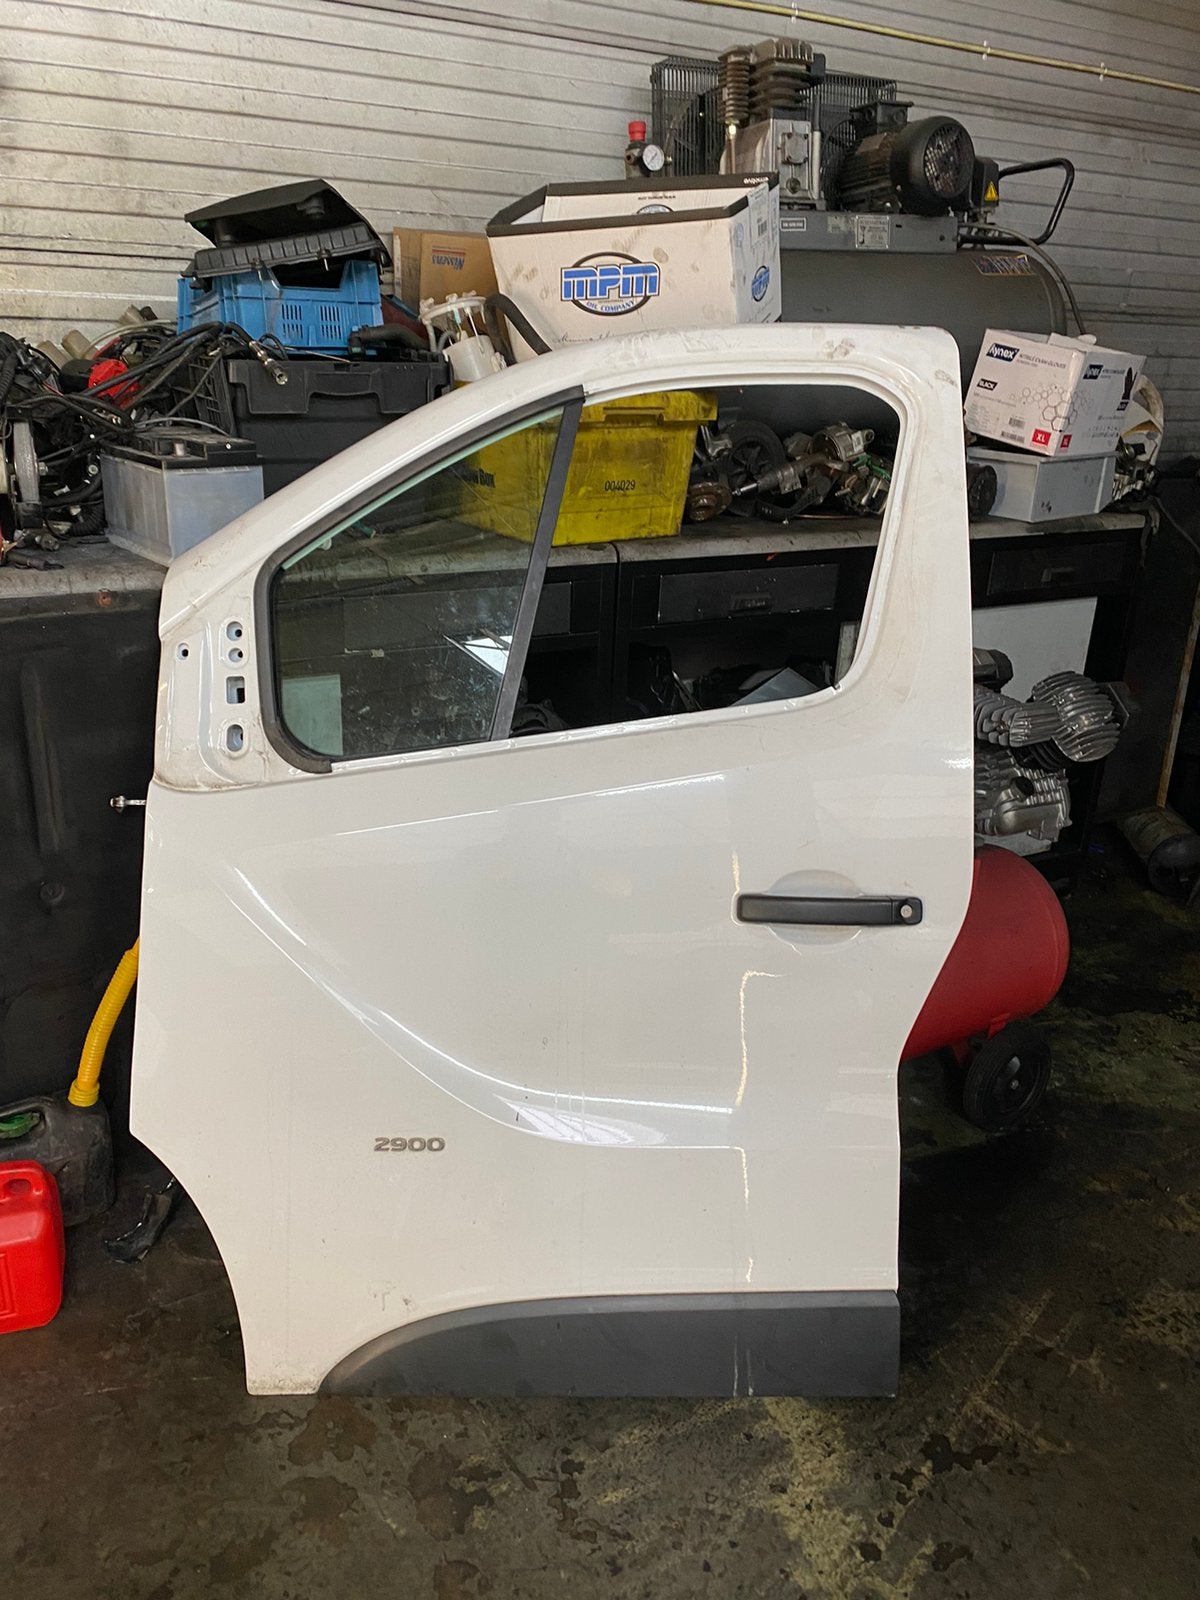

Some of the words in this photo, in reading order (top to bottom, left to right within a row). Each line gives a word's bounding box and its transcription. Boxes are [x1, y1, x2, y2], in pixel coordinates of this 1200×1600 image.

[586, 301, 598, 310] OIL
[600, 300, 635, 312] COMPANY
[1036, 433, 1046, 443] XL
[604, 479, 636, 491] 004029
[374, 1137, 446, 1152] 2900
